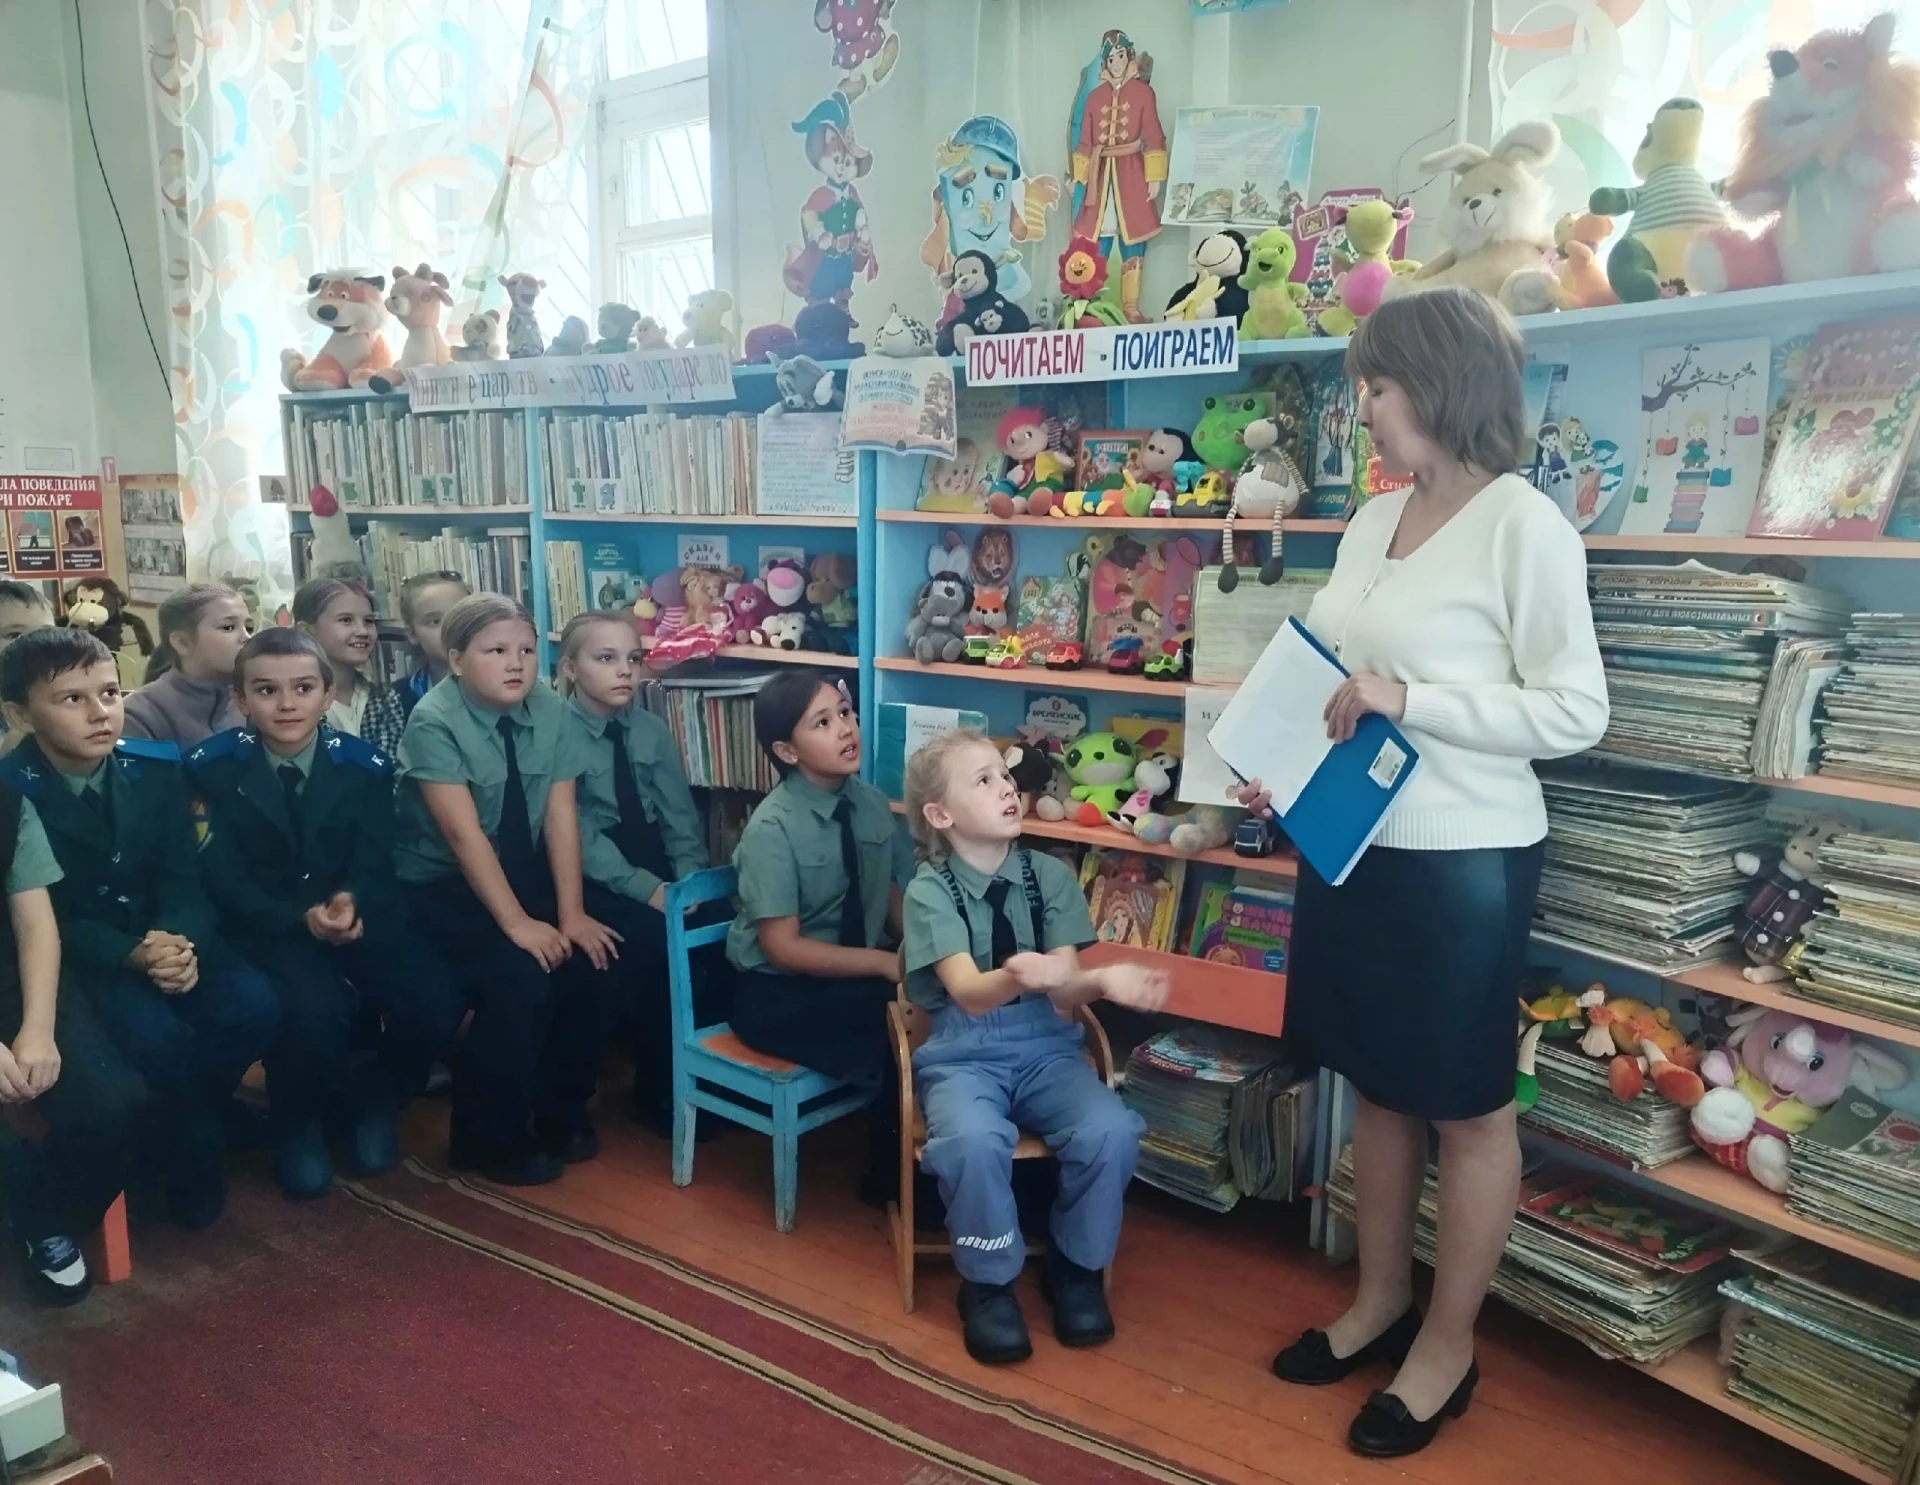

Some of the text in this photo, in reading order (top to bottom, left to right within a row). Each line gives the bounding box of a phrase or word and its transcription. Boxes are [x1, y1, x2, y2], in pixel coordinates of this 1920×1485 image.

[969, 333, 1085, 381] ПОЧИТАЕМ
[1113, 325, 1234, 371] ПОИГРАЕМ
[405, 368, 477, 406] Книжне
[481, 370, 541, 408] царств
[636, 352, 728, 402] государсво
[17, 493, 73, 507] ПОЖАРЕ
[21, 478, 96, 491] ПОВЕДЕНИЯ
